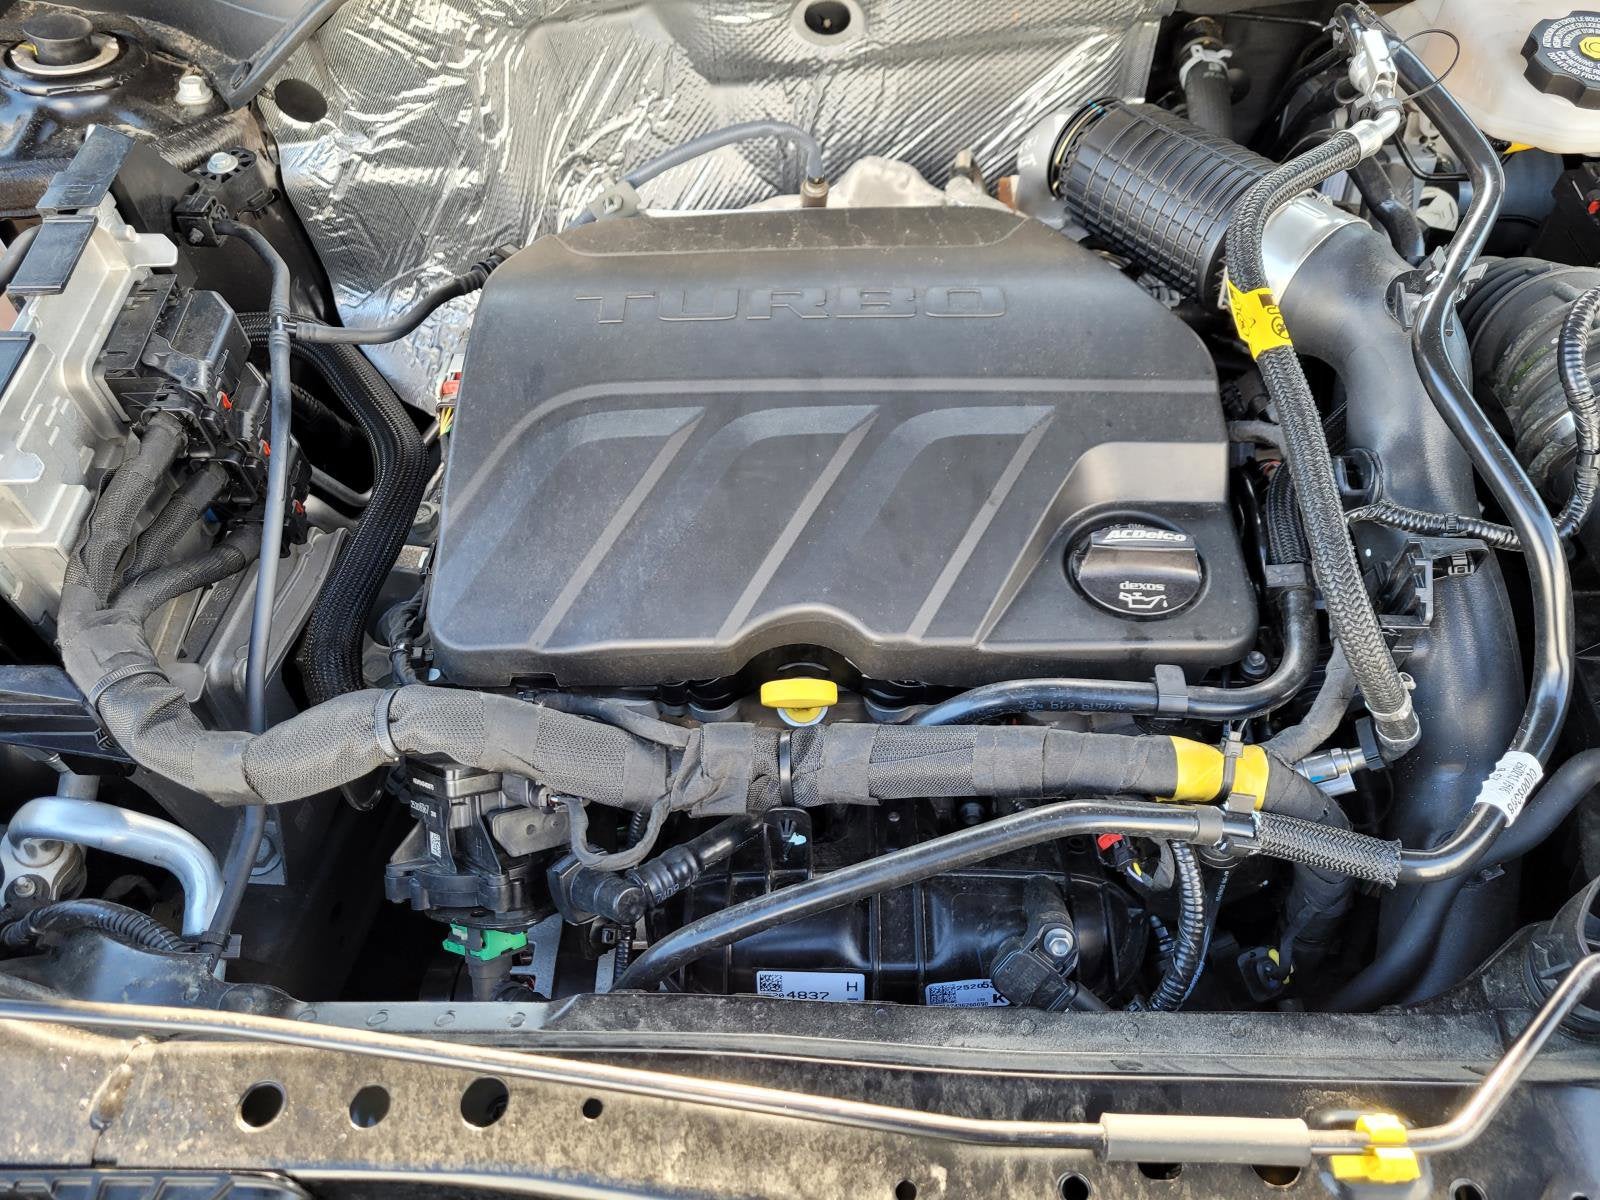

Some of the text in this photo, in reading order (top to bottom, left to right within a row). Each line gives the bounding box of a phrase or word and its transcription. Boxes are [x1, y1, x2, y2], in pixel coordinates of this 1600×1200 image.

[575, 287, 1008, 324] TURBO
[1104, 529, 1187, 542] ACDelco
[1119, 580, 1166, 591] dexos
